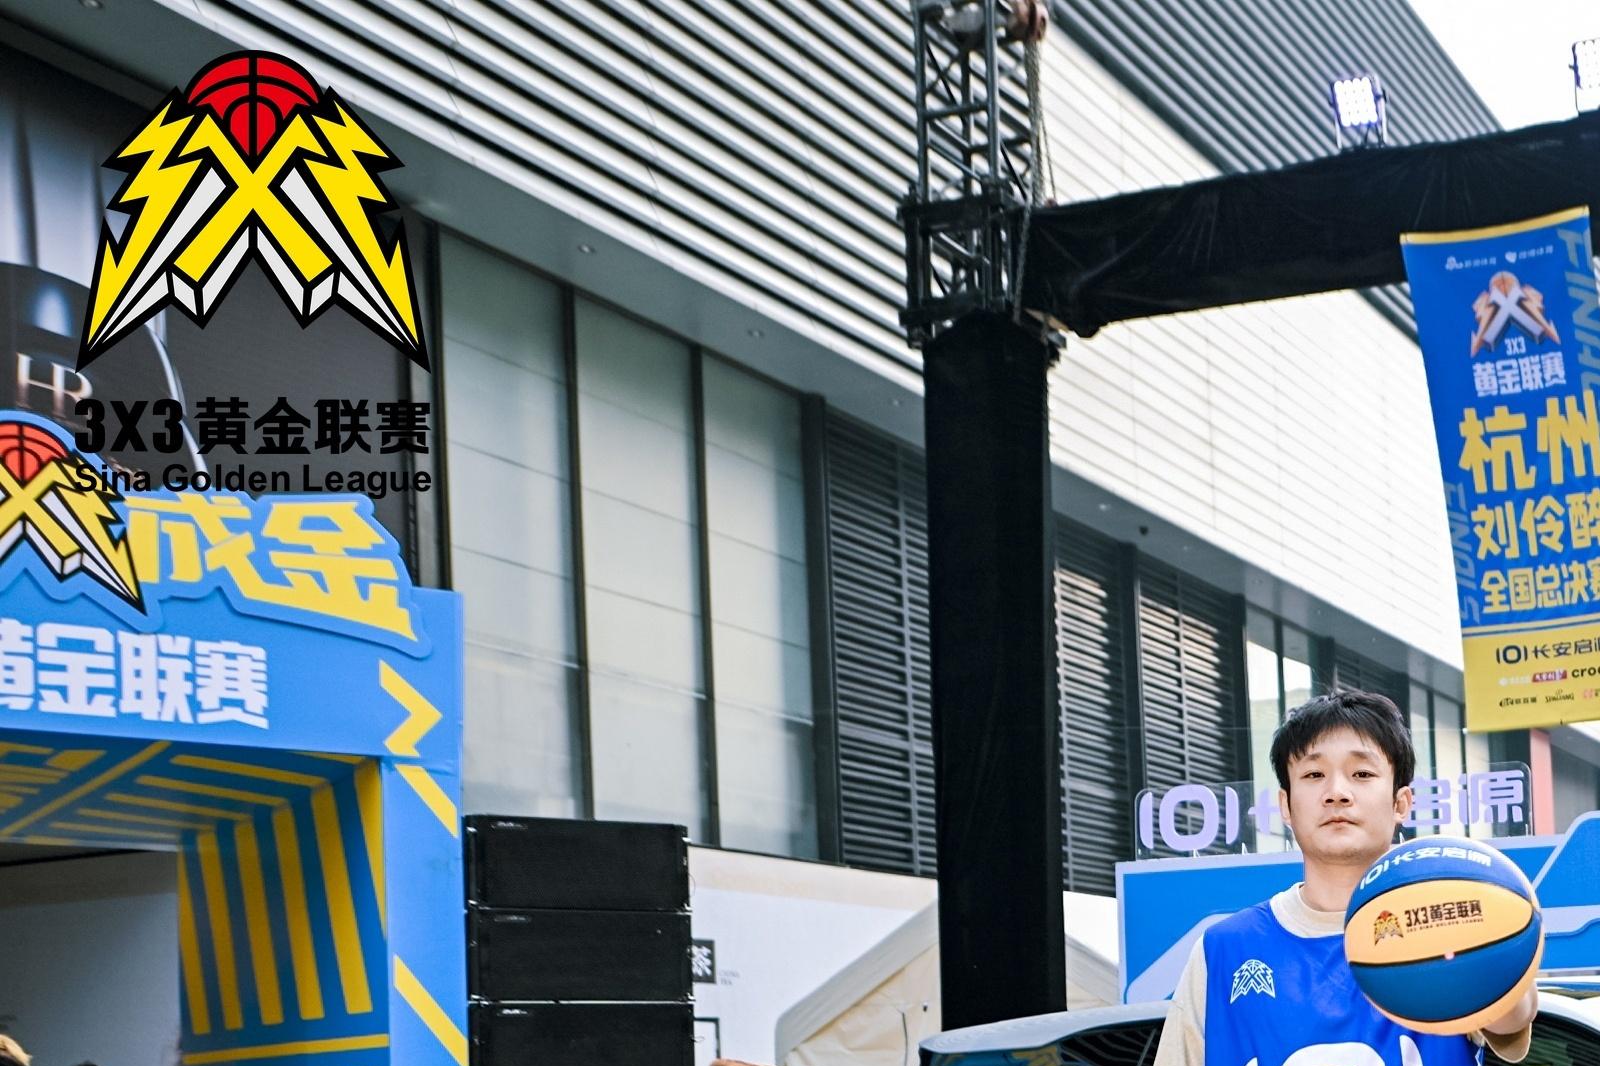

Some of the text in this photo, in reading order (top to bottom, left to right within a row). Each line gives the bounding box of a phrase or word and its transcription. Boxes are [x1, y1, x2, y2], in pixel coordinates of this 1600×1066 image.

[1504, 336, 1526, 356] 3X3
[1472, 351, 1567, 398] 黄金联赛
[126, 493, 418, 642] 成金
